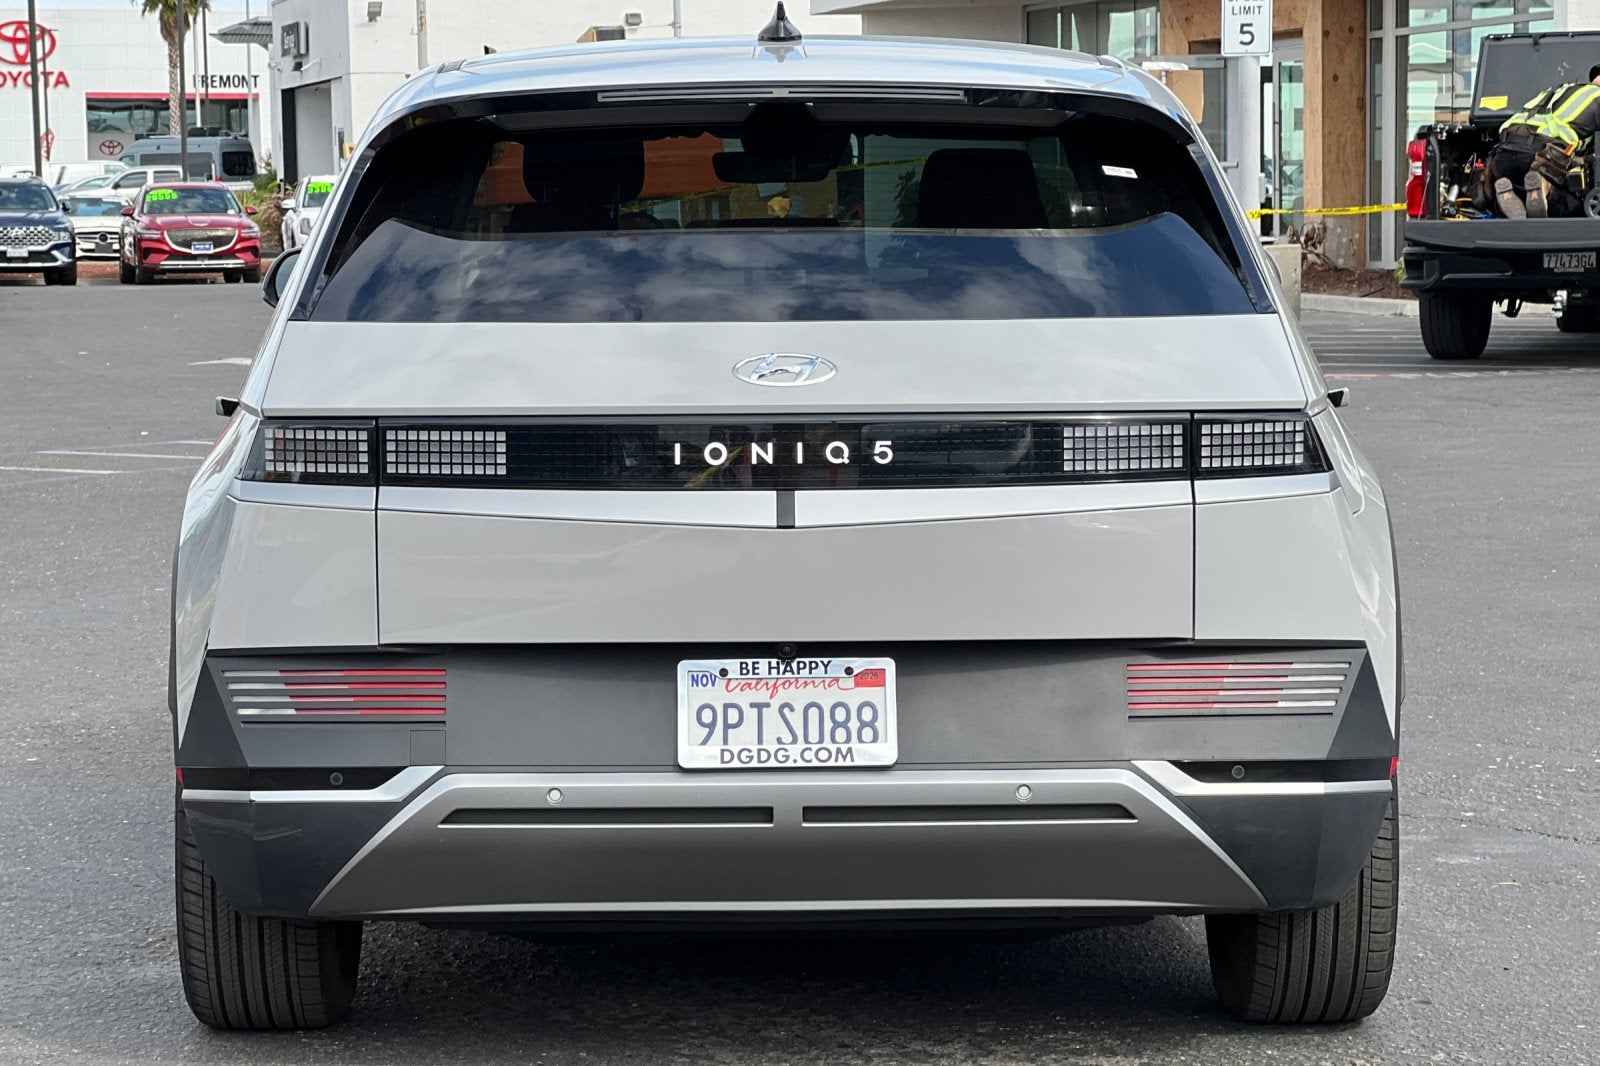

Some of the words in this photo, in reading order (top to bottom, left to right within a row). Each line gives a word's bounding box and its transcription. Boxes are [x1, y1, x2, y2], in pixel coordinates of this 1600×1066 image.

[1231, 5, 1263, 16] LIMIT
[1239, 22, 1255, 46] 5
[674, 441, 850, 466] IONIQ
[873, 440, 894, 465] 5
[739, 661, 761, 676] BE
[767, 660, 832, 676] HAPPY
[859, 671, 879, 680] 2026
[690, 674, 717, 688] NOV
[724, 677, 855, 700] California
[696, 700, 879, 746] 9PTS088
[720, 746, 855, 765] DGDG.COM
